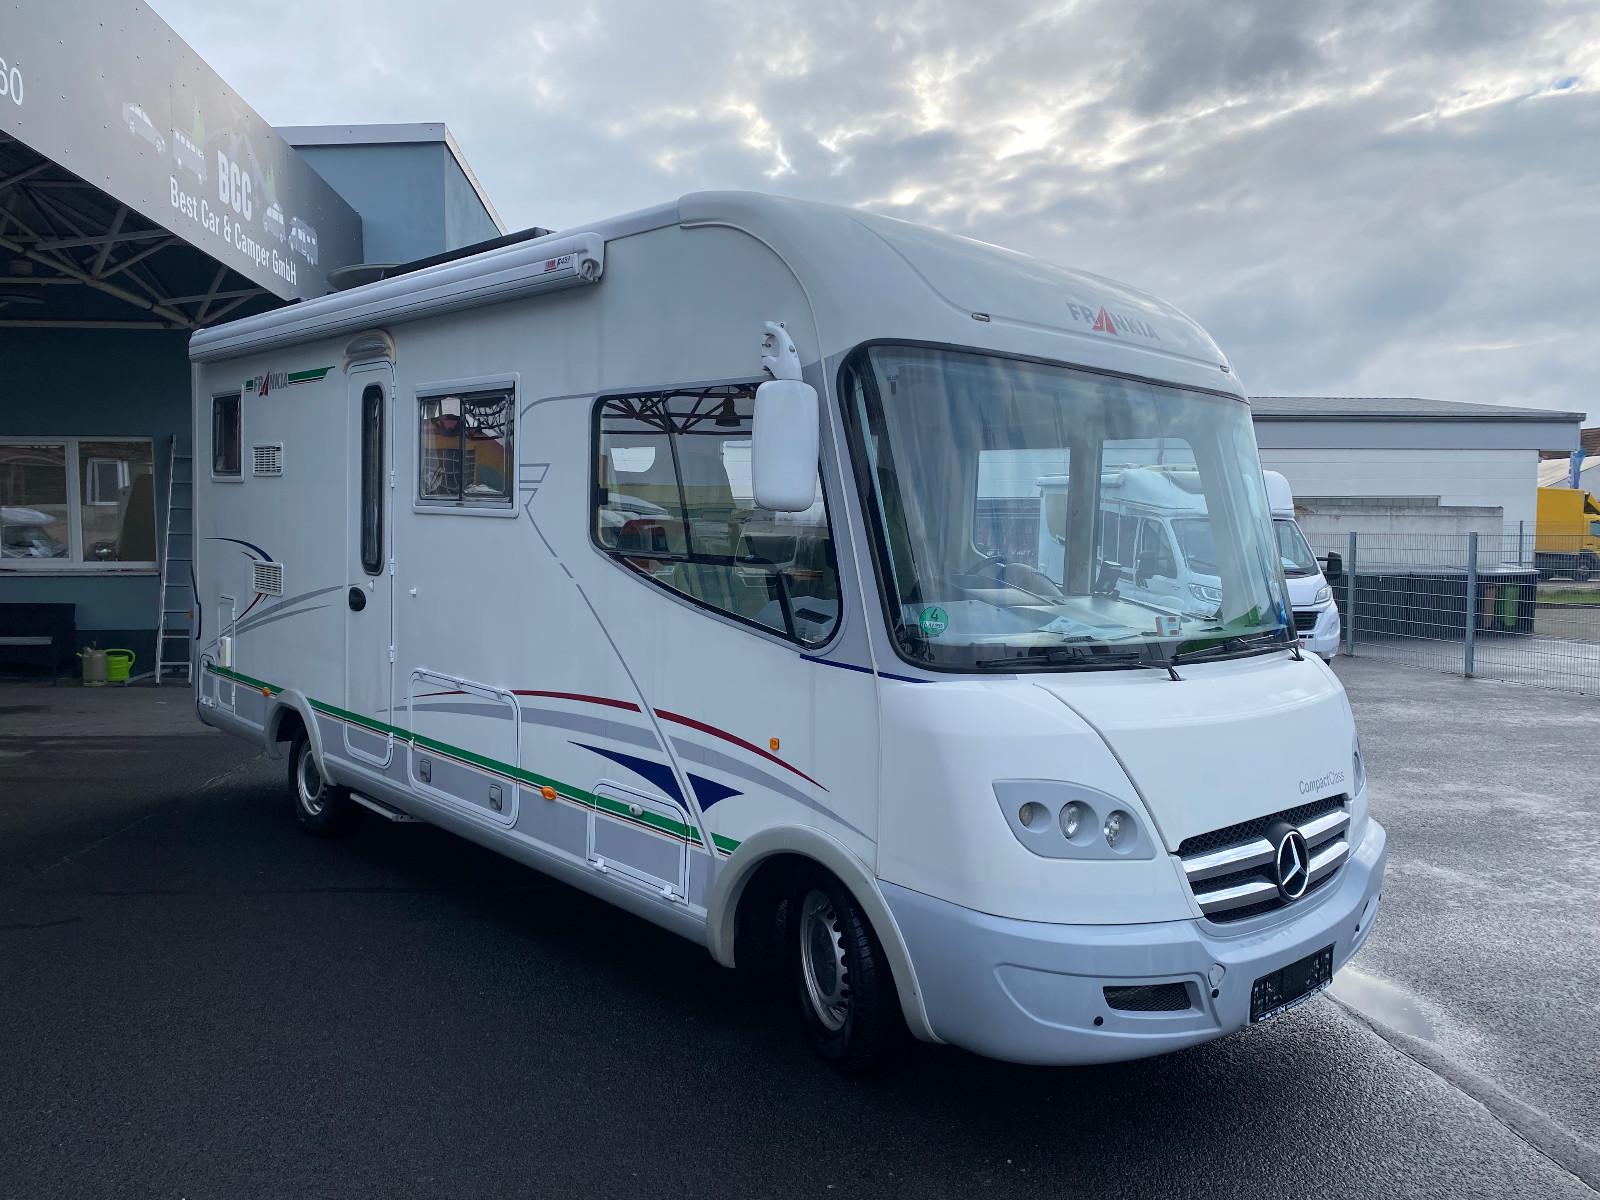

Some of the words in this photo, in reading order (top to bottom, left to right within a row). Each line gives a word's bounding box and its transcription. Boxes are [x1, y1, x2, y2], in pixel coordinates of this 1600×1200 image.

[217, 149, 252, 222] BCC
[169, 175, 199, 222] Best
[201, 199, 220, 236] Car
[223, 215, 232, 243] &
[234, 222, 270, 268] Camper
[272, 249, 297, 286] GmbH
[1065, 302, 1161, 340] FRANKIA
[253, 370, 288, 397] FRANKIA
[930, 607, 940, 621] 4
